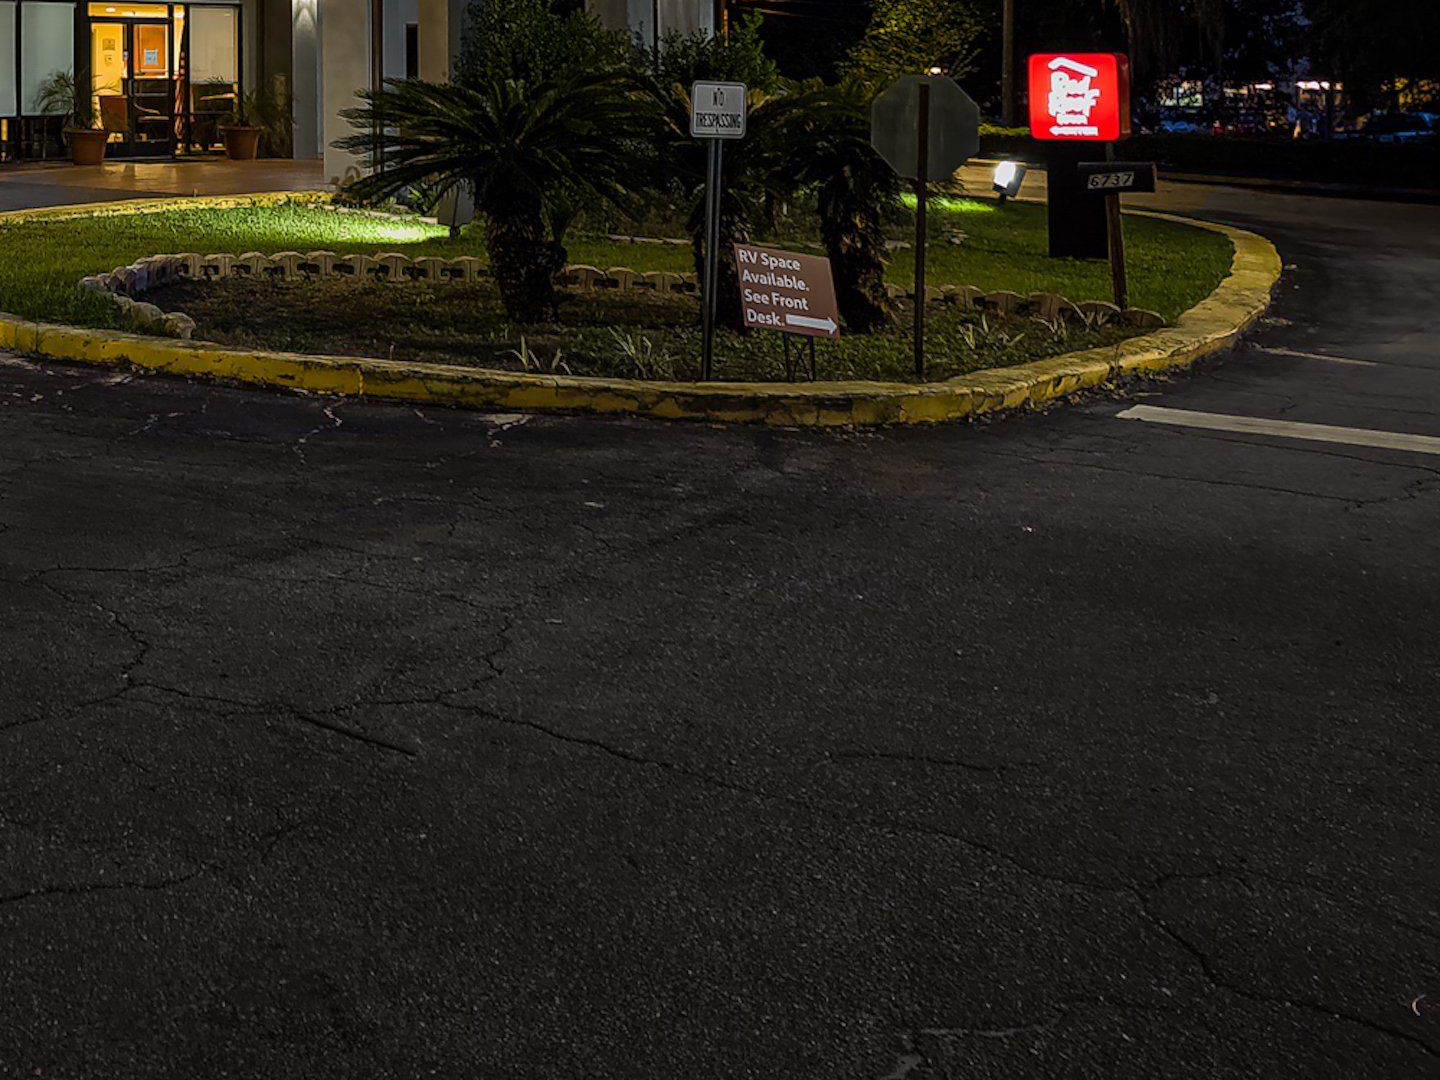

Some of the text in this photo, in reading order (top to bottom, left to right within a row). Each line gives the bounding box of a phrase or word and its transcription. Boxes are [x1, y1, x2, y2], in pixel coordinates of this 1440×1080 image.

[712, 88, 725, 107] NO
[695, 112, 742, 129] TRESPASSING
[1090, 173, 1132, 187] 6737
[738, 249, 801, 271] RV Space
[742, 269, 810, 291] Available.
[744, 288, 809, 311] See Front
[746, 308, 786, 327] Desk.
